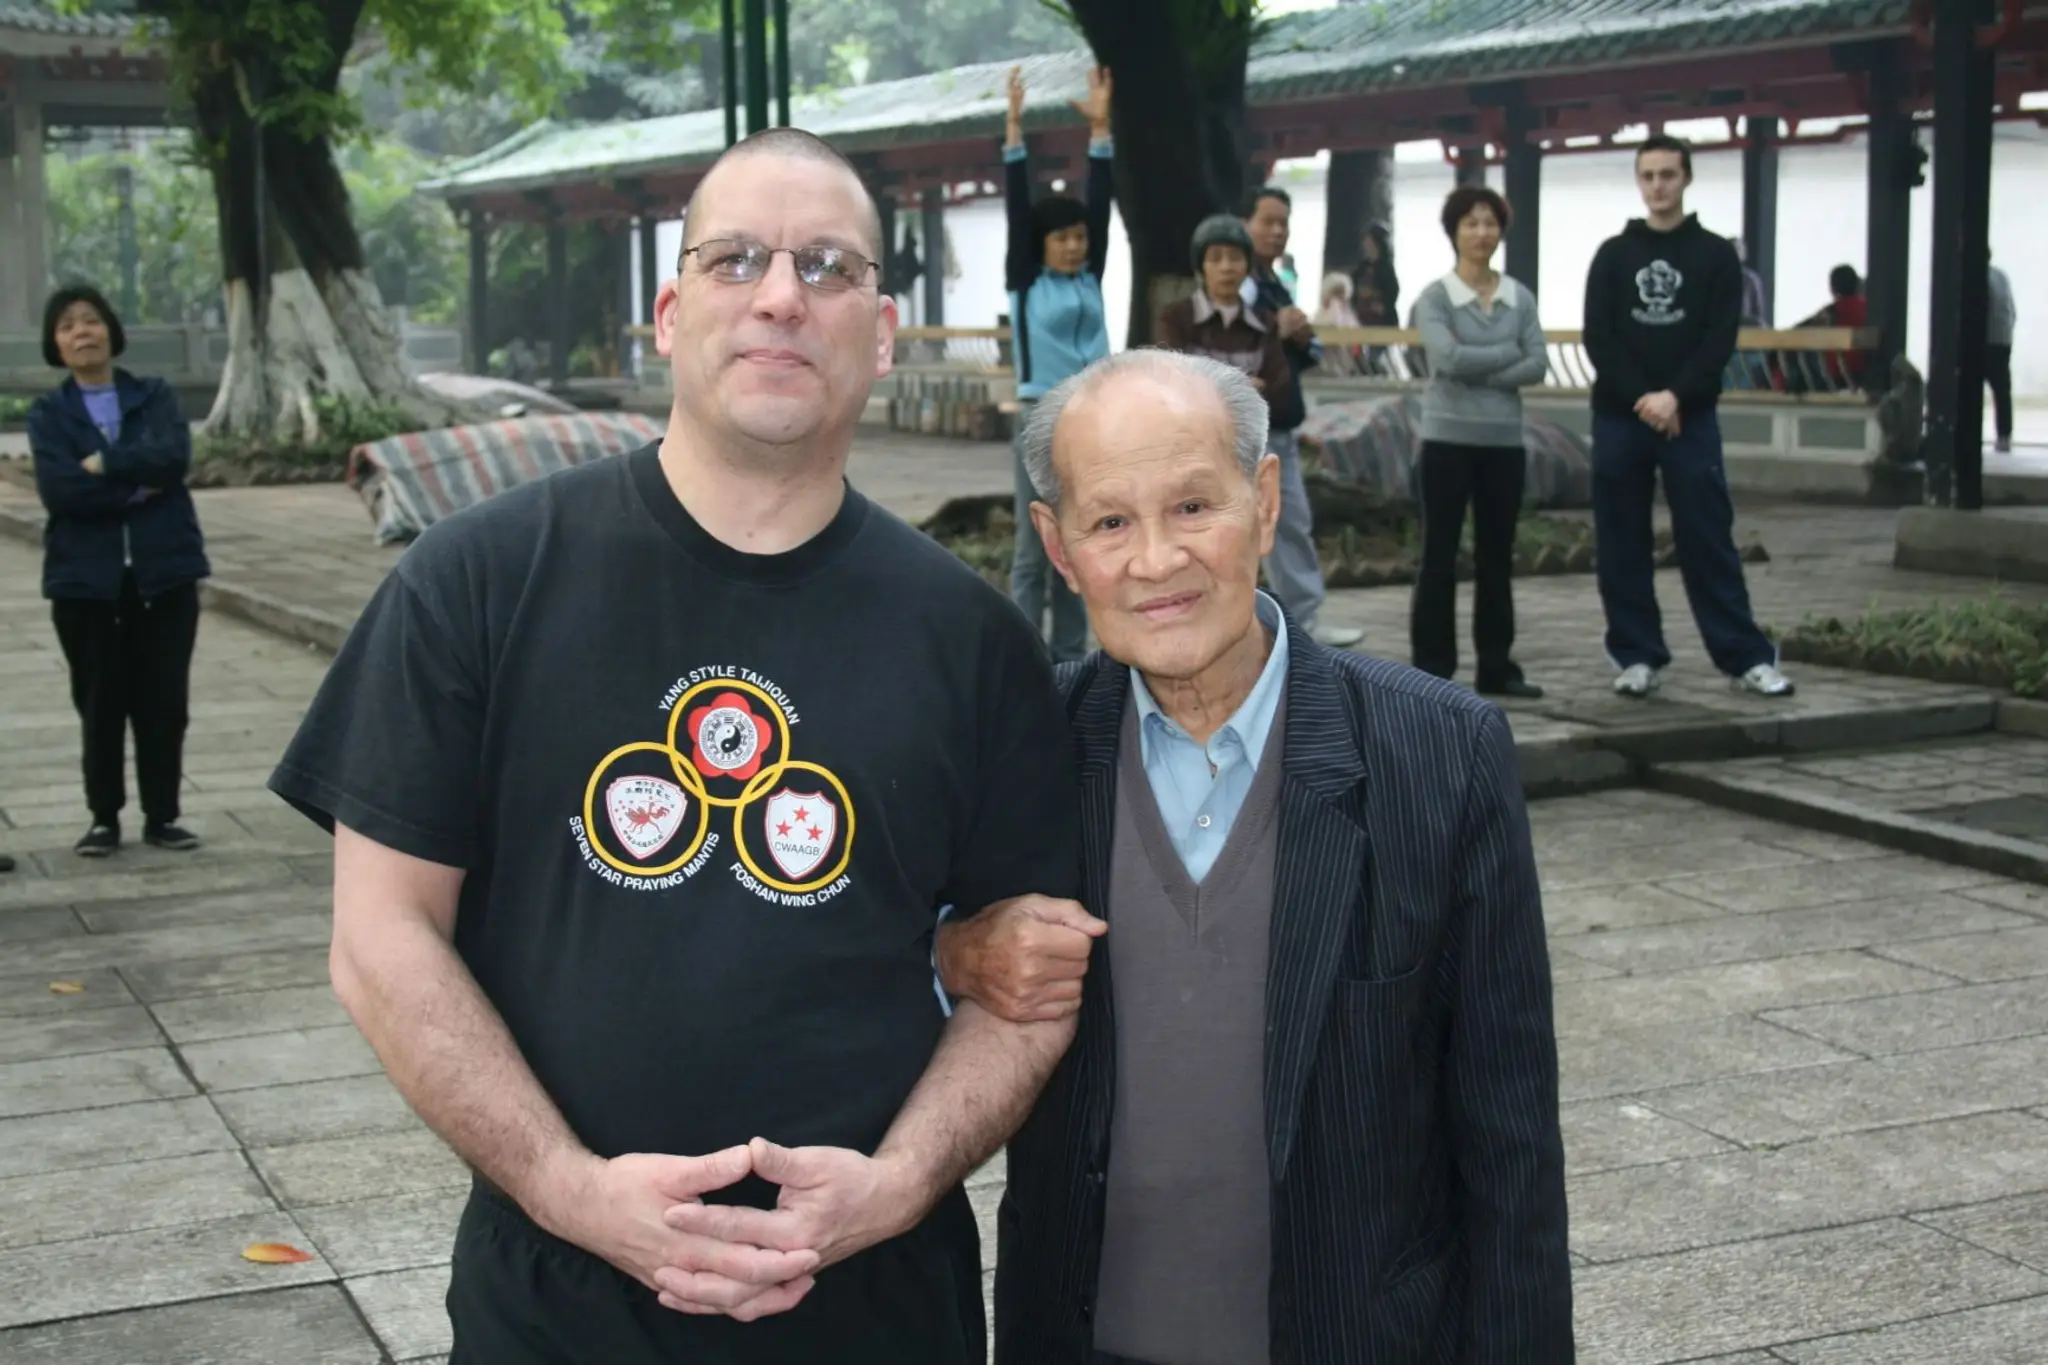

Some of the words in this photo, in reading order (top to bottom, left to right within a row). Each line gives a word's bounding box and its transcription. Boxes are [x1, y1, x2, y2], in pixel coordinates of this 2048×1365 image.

[658, 677, 689, 711] YANG
[689, 665, 736, 683] STYLE
[739, 667, 800, 725] TAIJIQUAN
[569, 816, 592, 861] SEVEN
[588, 860, 622, 885] STAR
[623, 872, 684, 891] PRAYING
[682, 832, 720, 878] MANTIS
[774, 841, 821, 856] CWAAGB
[729, 862, 779, 904] FOSHAN
[781, 893, 816, 907] WING
[817, 874, 851, 903] CHUN
